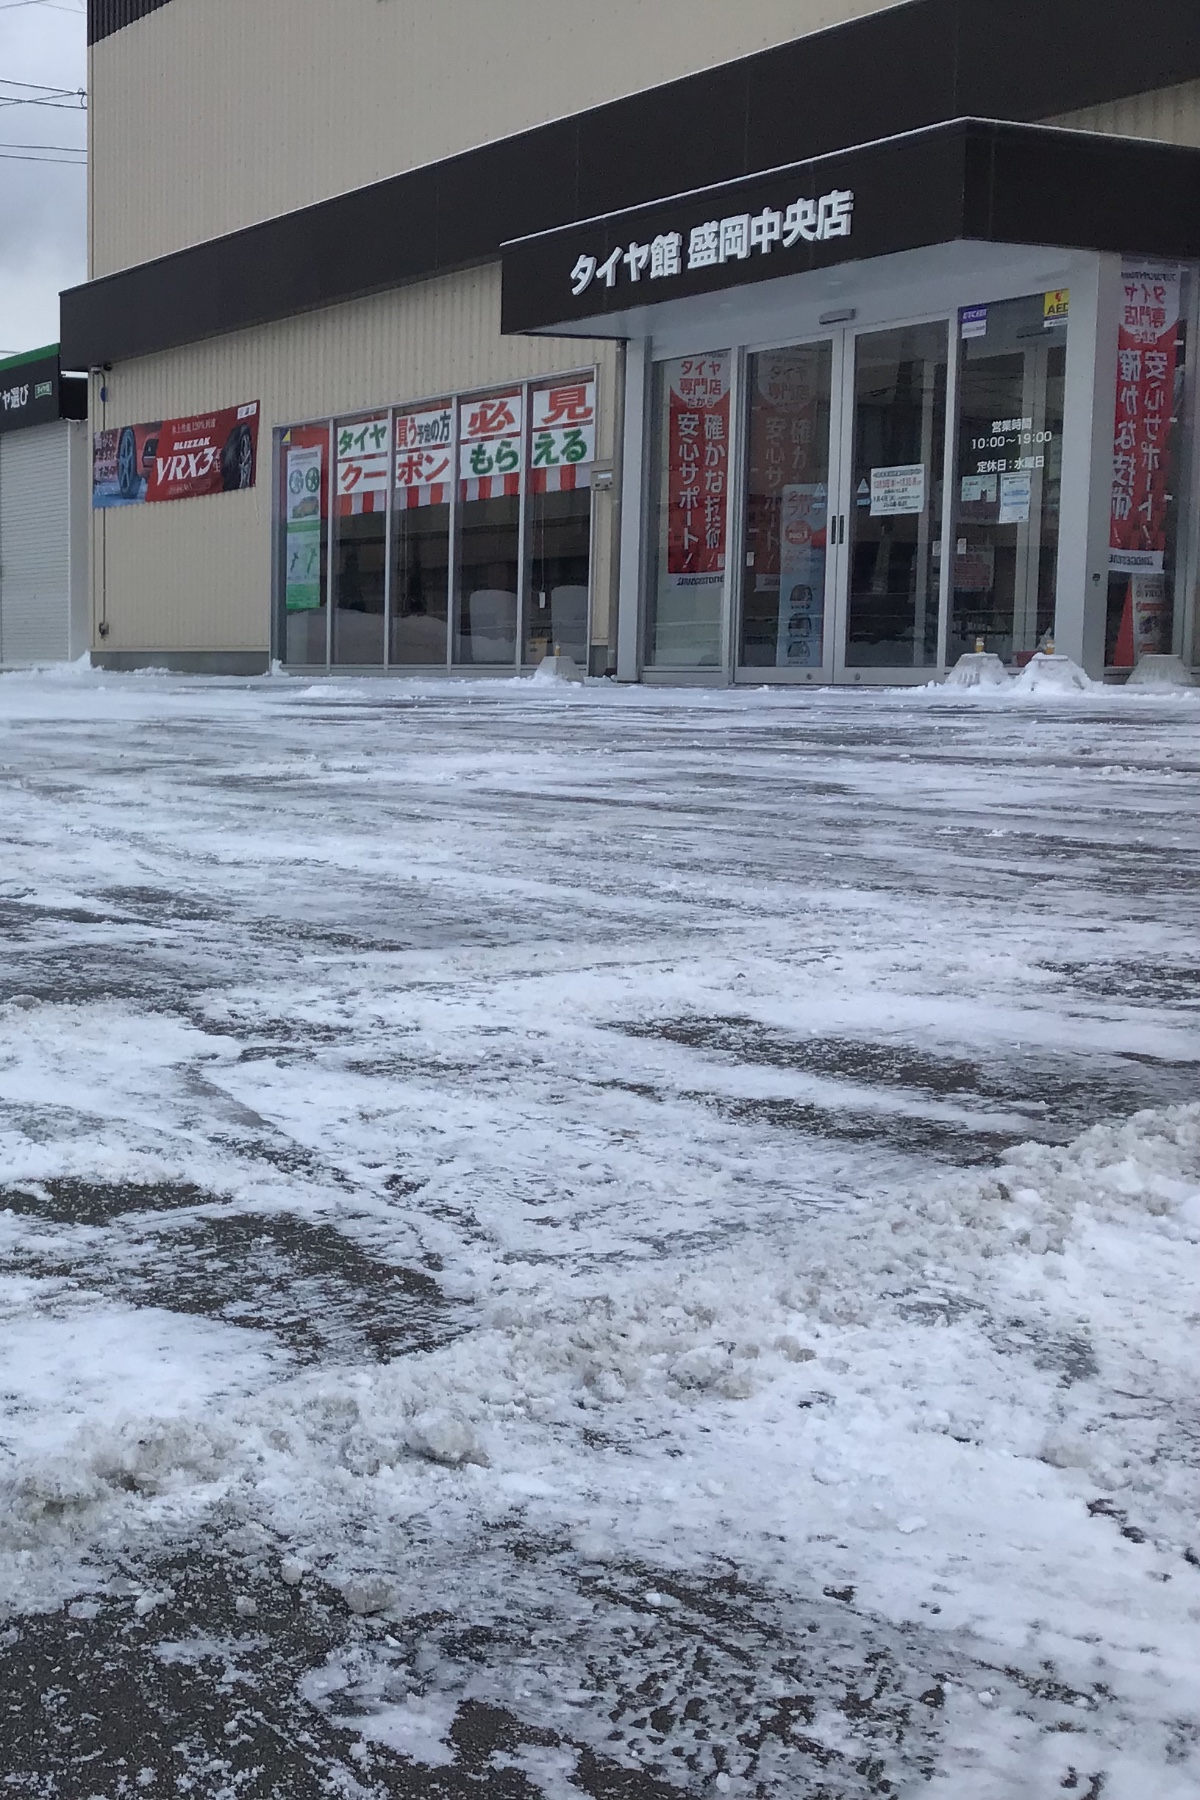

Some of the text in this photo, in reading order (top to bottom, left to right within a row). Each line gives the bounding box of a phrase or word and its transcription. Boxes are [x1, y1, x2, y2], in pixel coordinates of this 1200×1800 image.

[569, 189, 855, 295] タイヤ館 盛岡中央店
[680, 360, 721, 376] タイヤ
[680, 378, 721, 396] 専門店
[687, 398, 715, 408] だから
[338, 423, 387, 455] タイヤ
[397, 411, 451, 448] 買う予定の方
[991, 417, 1032, 434] 営業時間
[173, 437, 211, 451] BLIZZAK
[156, 446, 217, 486] VRX3
[677, 413, 700, 569] 安心サポート！
[704, 413, 726, 569] 確かな技術！
